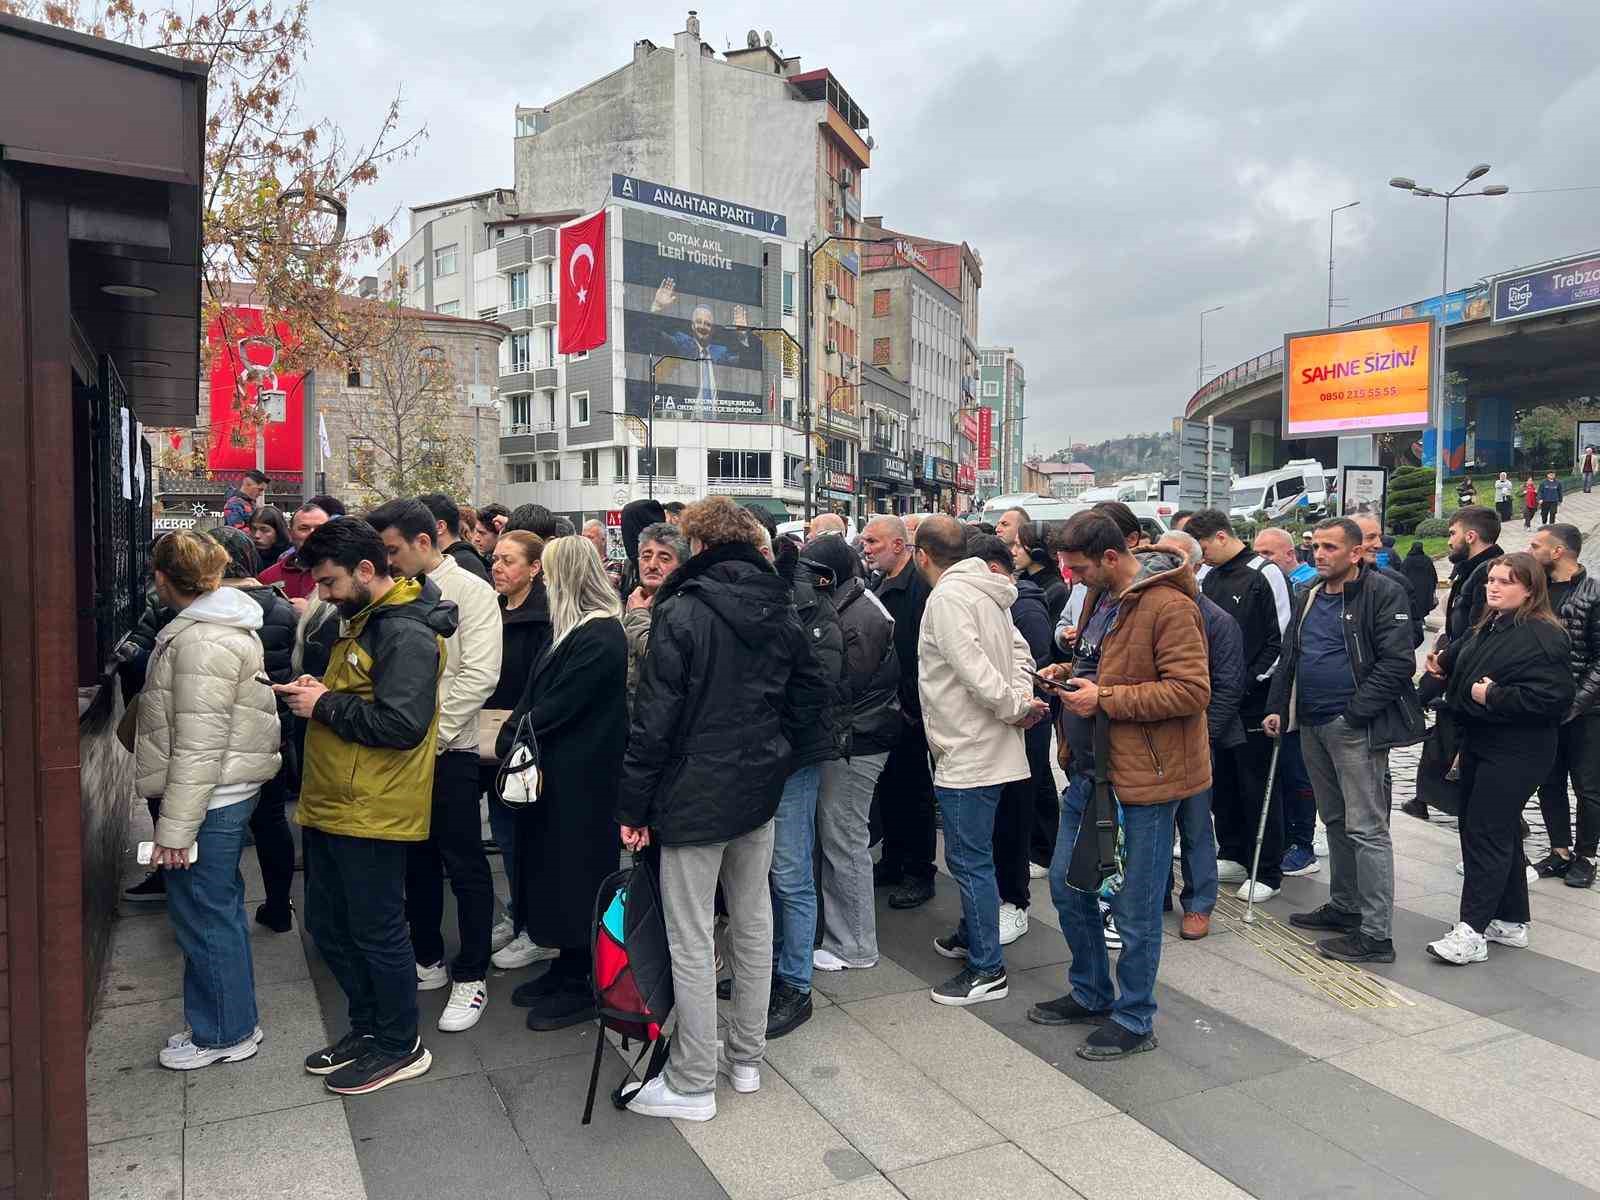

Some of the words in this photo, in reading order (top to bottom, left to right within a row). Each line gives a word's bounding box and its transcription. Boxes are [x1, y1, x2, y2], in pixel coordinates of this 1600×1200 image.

[653, 188, 718, 217] ANAHTAR
[720, 204, 754, 225] PARTİ
[668, 231, 700, 249] ORTAK
[702, 239, 723, 253] AKIL
[658, 241, 684, 261] İLERİ
[686, 249, 733, 271] TÜRKİYE
[1302, 360, 1360, 384] SAHNE
[1364, 345, 1417, 374] SİZİN!
[1320, 391, 1344, 402] 0850
[1347, 389, 1365, 400] 215
[1368, 388, 1381, 399] 55
[1383, 386, 1398, 397] 55
[155, 519, 197, 530] KEBAP
